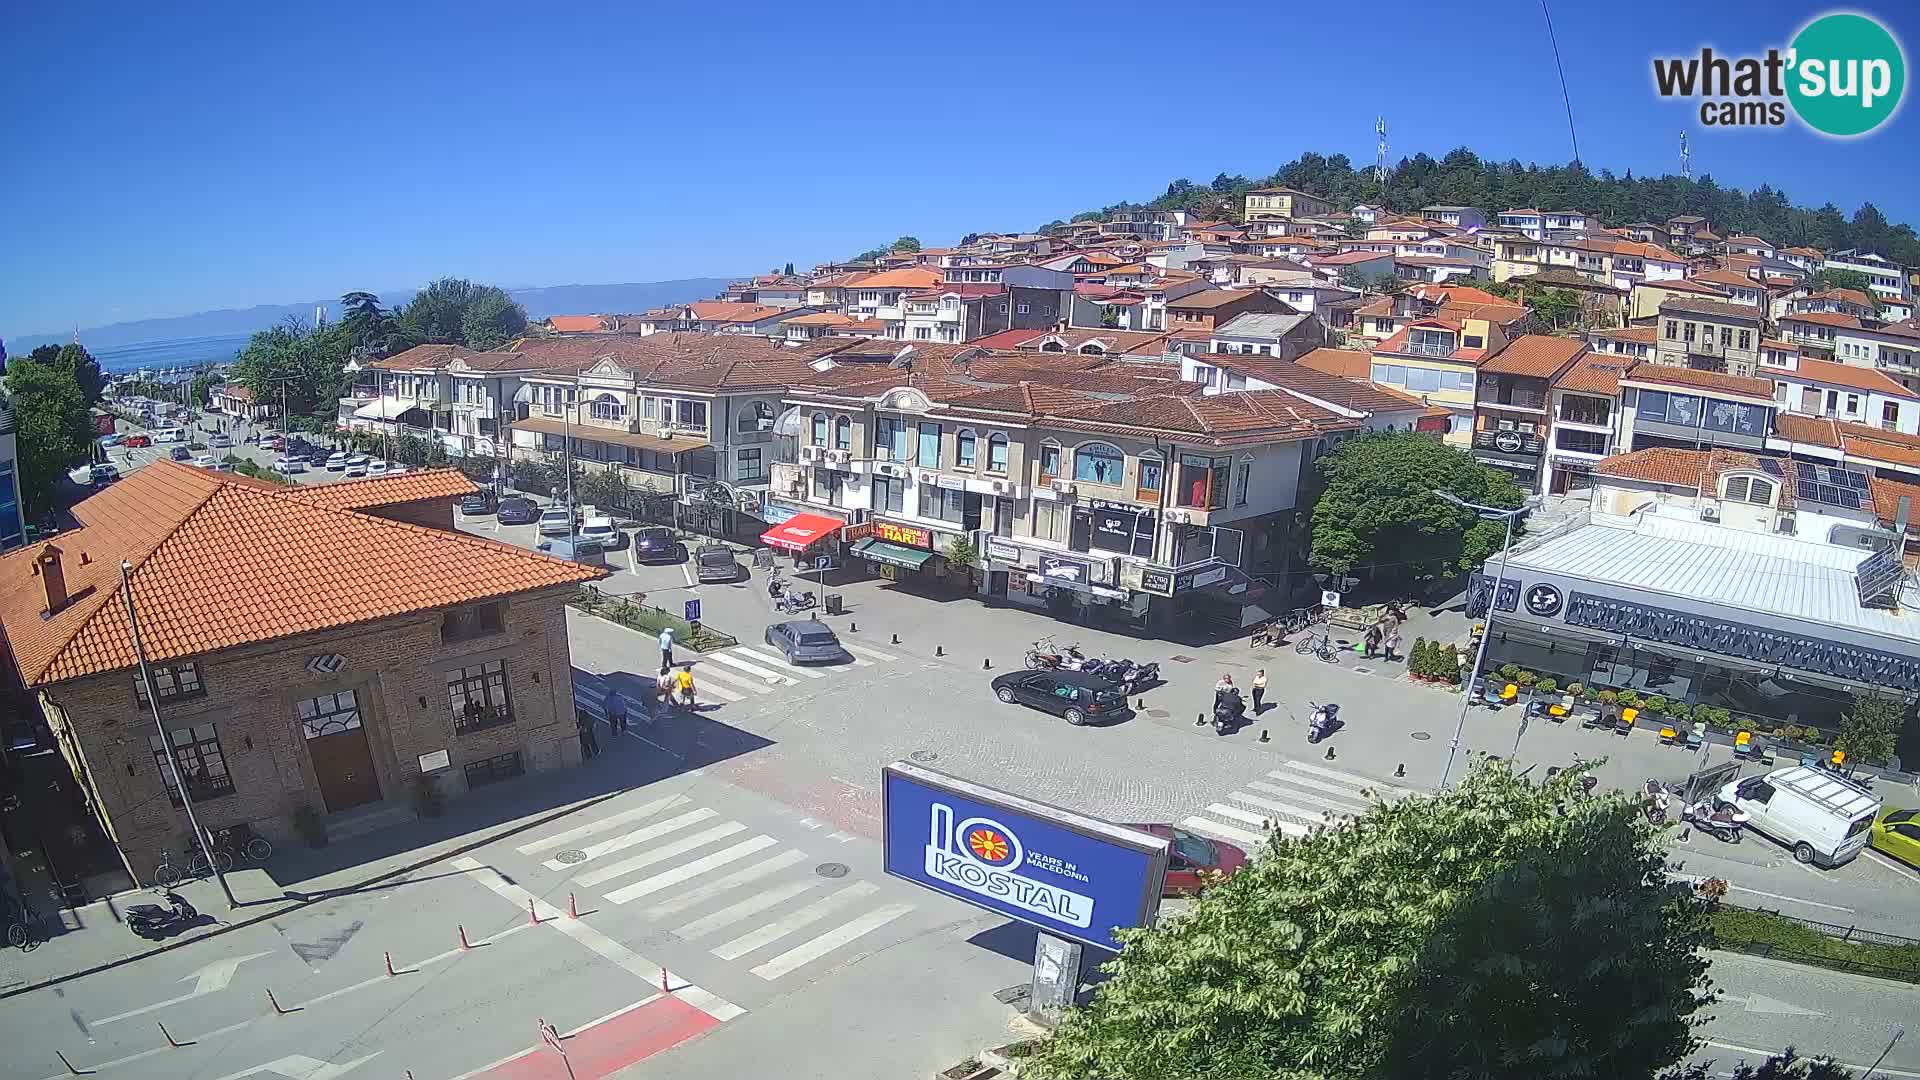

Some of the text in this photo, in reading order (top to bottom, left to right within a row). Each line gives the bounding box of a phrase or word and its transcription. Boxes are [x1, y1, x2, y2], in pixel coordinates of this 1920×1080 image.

[1026, 857, 1090, 883] MACEDONIA
[1027, 850, 1077, 871] YEARS IN
[935, 853, 1080, 921] KOSTAL
